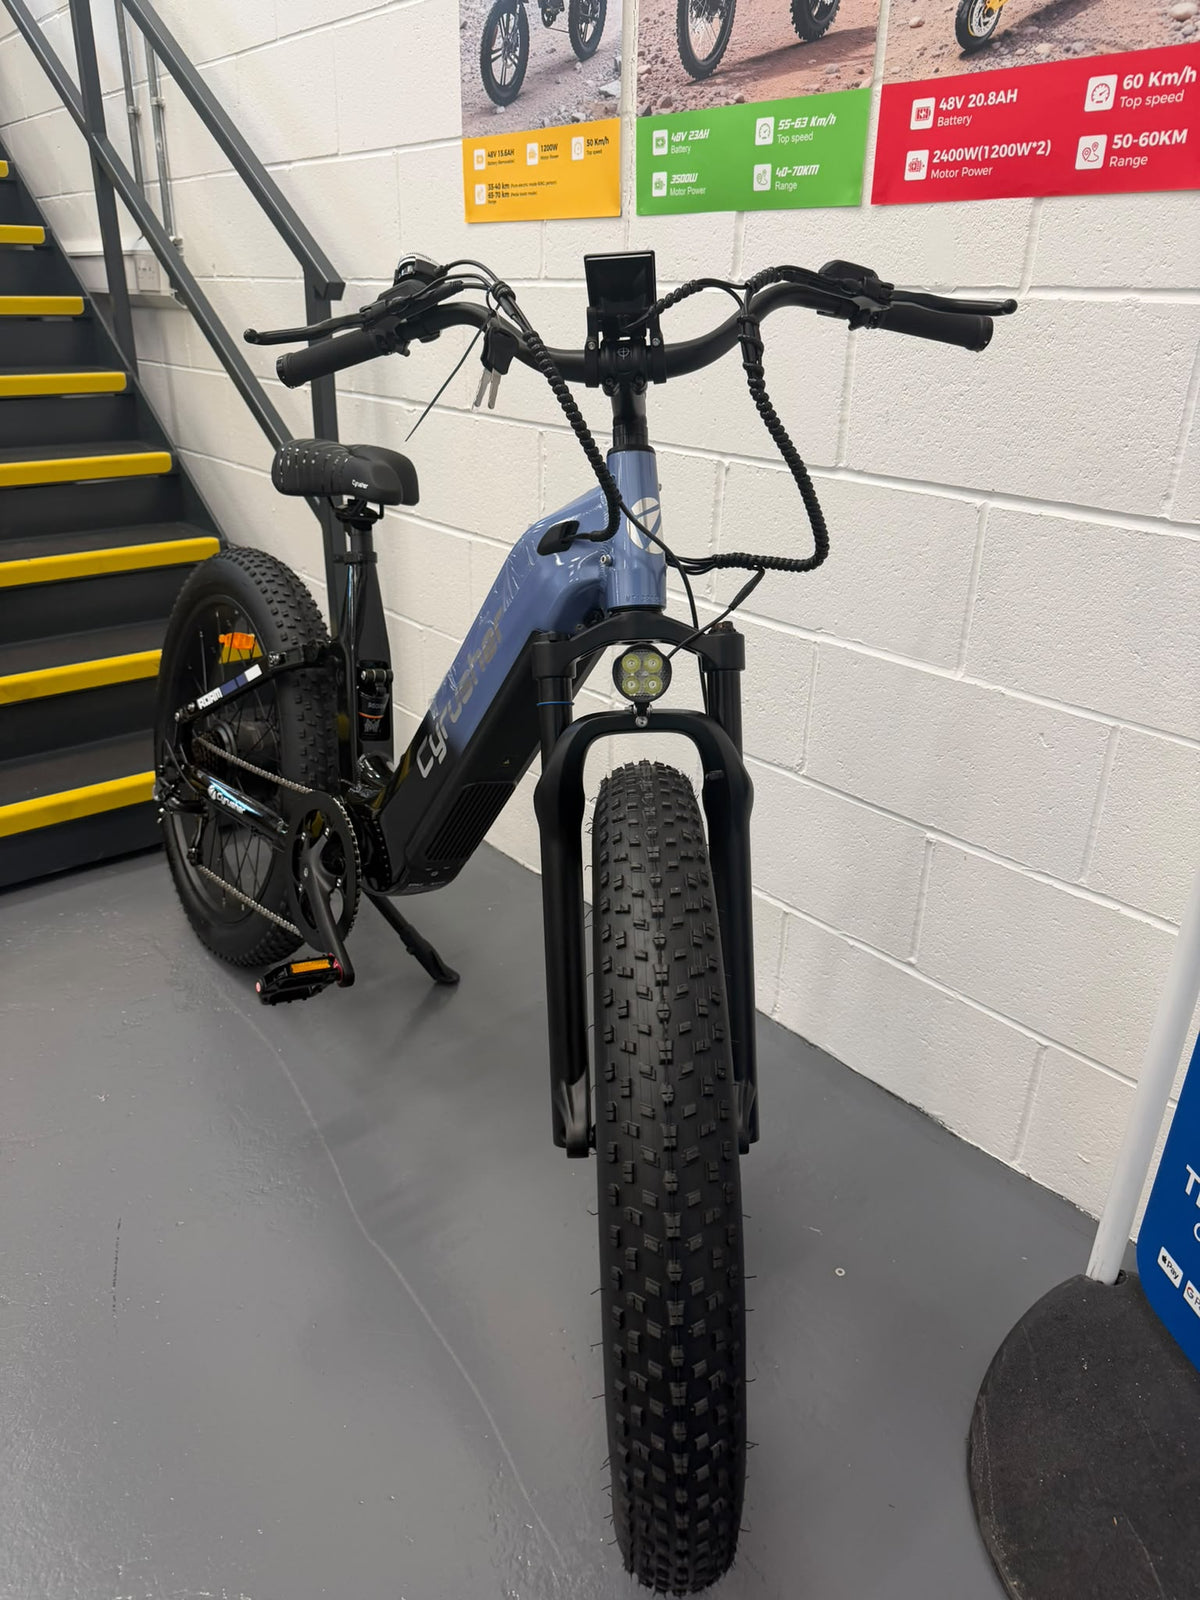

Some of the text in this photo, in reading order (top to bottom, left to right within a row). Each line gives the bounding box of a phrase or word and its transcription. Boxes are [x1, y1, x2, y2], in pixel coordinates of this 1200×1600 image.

[1122, 65, 1197, 91] 60 Km/h
[939, 88, 1018, 112] 48V 20.8AH
[1119, 89, 1185, 111] Top speed
[777, 112, 837, 131] 55-63 Km/h
[937, 114, 972, 128] Battery
[586, 136, 609, 147] 50 Km/h
[671, 128, 710, 141] 48V 23AH
[777, 131, 813, 144] Top speed
[1111, 128, 1188, 150] 50-60KM
[540, 144, 558, 153] 1200W
[670, 144, 691, 154] Battery
[1109, 154, 1148, 169] Range
[670, 172, 698, 184] 3500W
[776, 164, 820, 178] 40-70KM
[930, 165, 993, 180] Motor Power
[669, 186, 706, 196] Motor Power
[775, 182, 798, 193] Range
[1167, 1261, 1179, 1280] Pay
